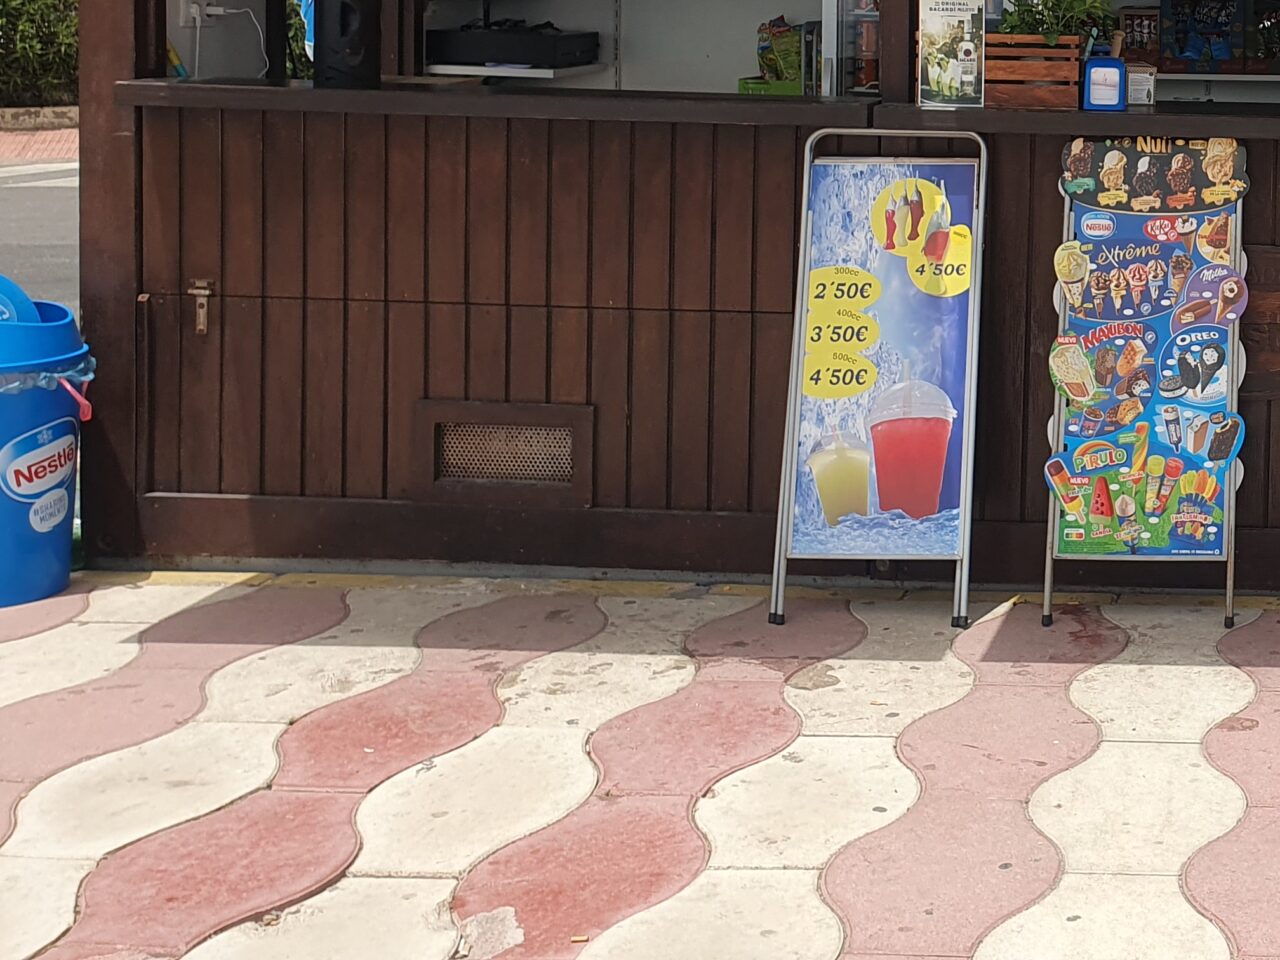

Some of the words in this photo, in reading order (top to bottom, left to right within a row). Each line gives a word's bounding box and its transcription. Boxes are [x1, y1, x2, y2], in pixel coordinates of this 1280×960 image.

[834, 266, 860, 277] 300cc
[1200, 267, 1229, 282] Milka
[836, 308, 862, 322] 400cc
[1080, 322, 1144, 353] MAXIBON
[1175, 331, 1219, 346] OREO
[832, 352, 858, 365] 500cc
